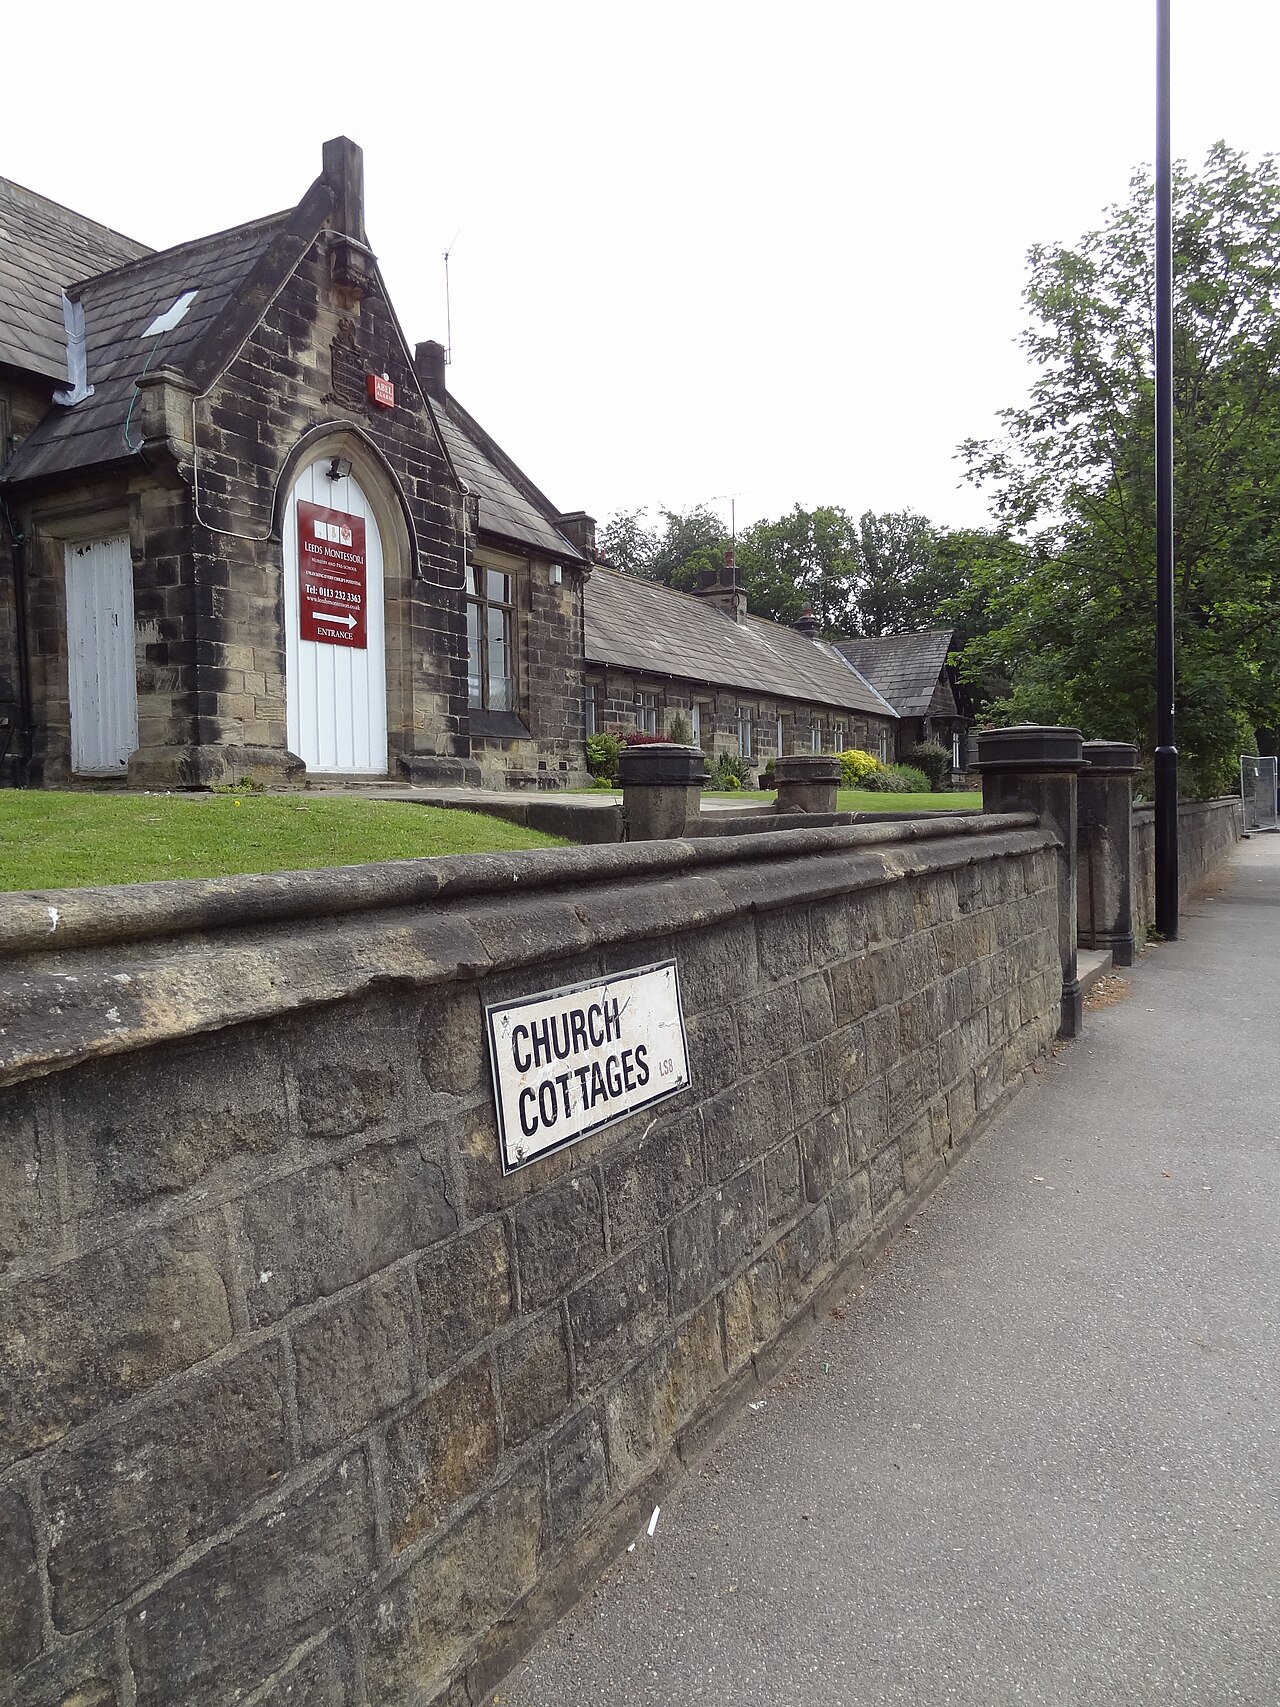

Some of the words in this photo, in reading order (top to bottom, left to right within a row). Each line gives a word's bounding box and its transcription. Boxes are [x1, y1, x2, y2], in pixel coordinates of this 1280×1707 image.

[304, 541, 323, 555] LEEDS
[324, 546, 364, 565] MONTESSORI
[305, 583, 318, 594] Tel:
[319, 586, 334, 598] 0113
[335, 590, 346, 601] 232
[346, 593, 361, 603] 3363
[317, 627, 354, 640] ENTRANCE
[512, 997, 622, 1073] CHURCH
[518, 1044, 650, 1137] COTTAGES
[659, 1058, 674, 1077] LS8
